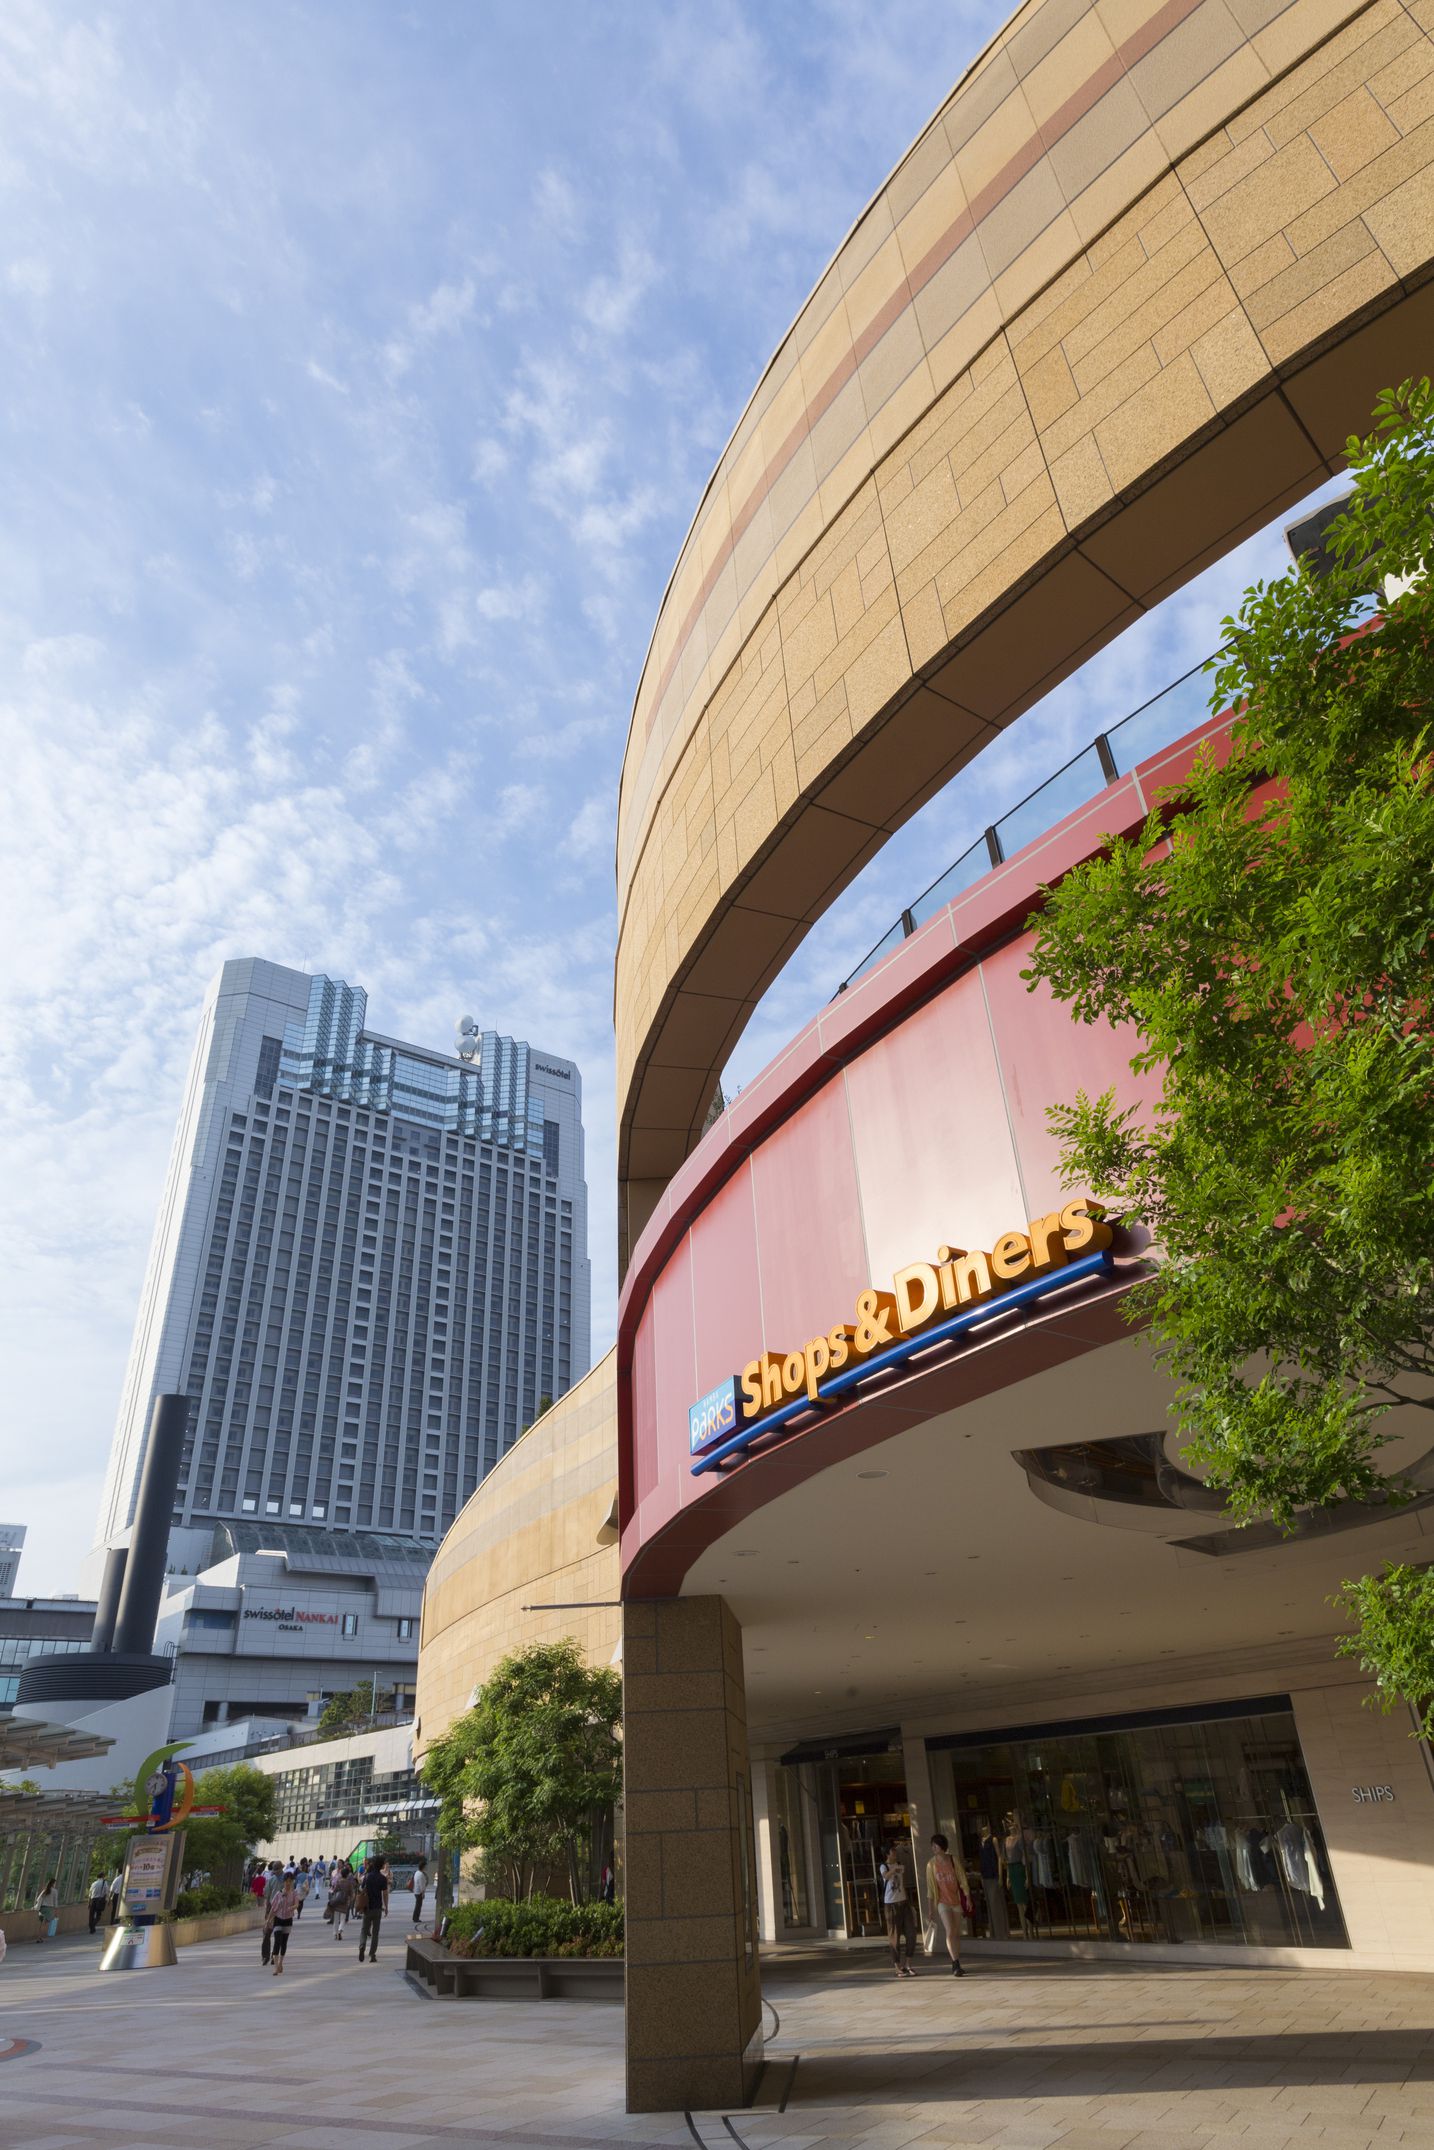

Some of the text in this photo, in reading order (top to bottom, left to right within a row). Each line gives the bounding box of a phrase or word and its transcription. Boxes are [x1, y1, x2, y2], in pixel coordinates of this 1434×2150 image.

[741, 1197, 1100, 1418] Shops & Diners
[295, 1611, 339, 1625] NANKAI
[278, 1624, 303, 1632] OSAKA
[1351, 1785, 1394, 1803] SHIPS
